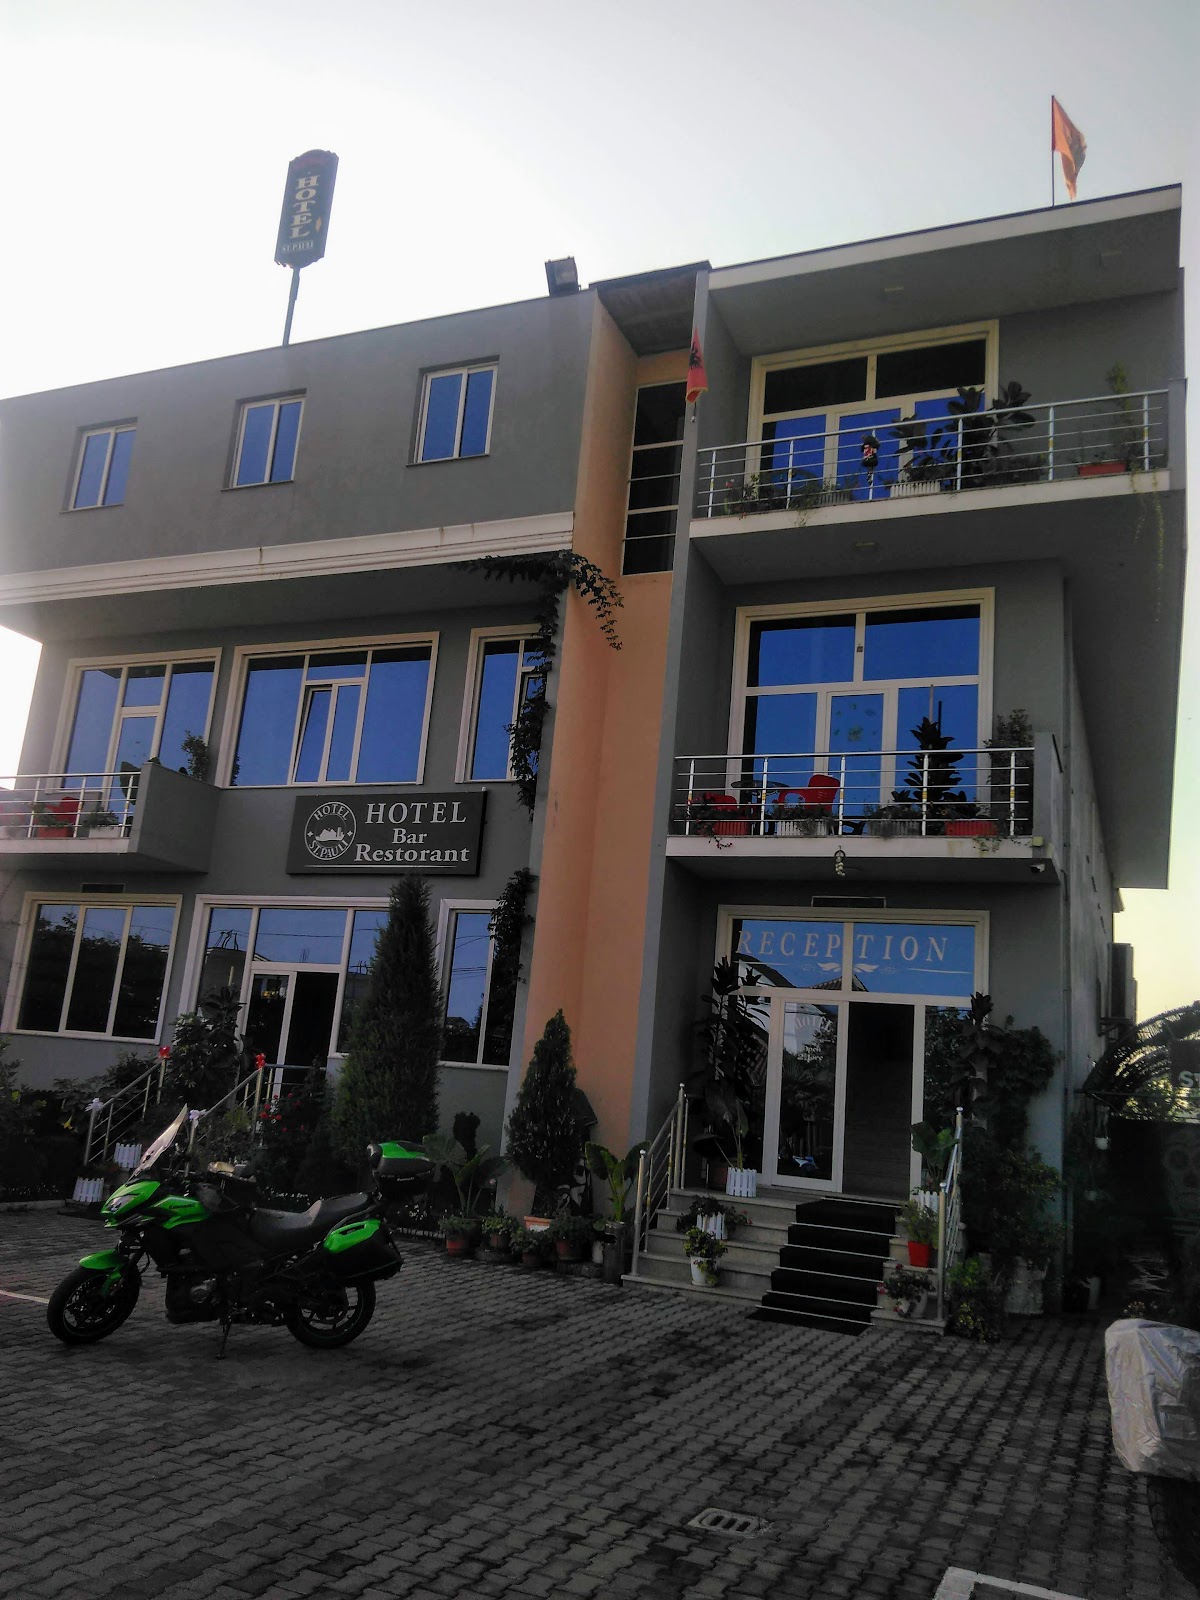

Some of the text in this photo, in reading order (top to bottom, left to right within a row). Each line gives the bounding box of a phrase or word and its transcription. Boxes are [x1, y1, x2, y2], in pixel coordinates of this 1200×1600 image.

[289, 175, 321, 239] HOTEL
[314, 803, 350, 821] HOTEL
[365, 801, 467, 824] HOTEL
[391, 828, 428, 844] Bar
[354, 843, 470, 862] Restorant
[735, 930, 949, 962] RECEPTION
